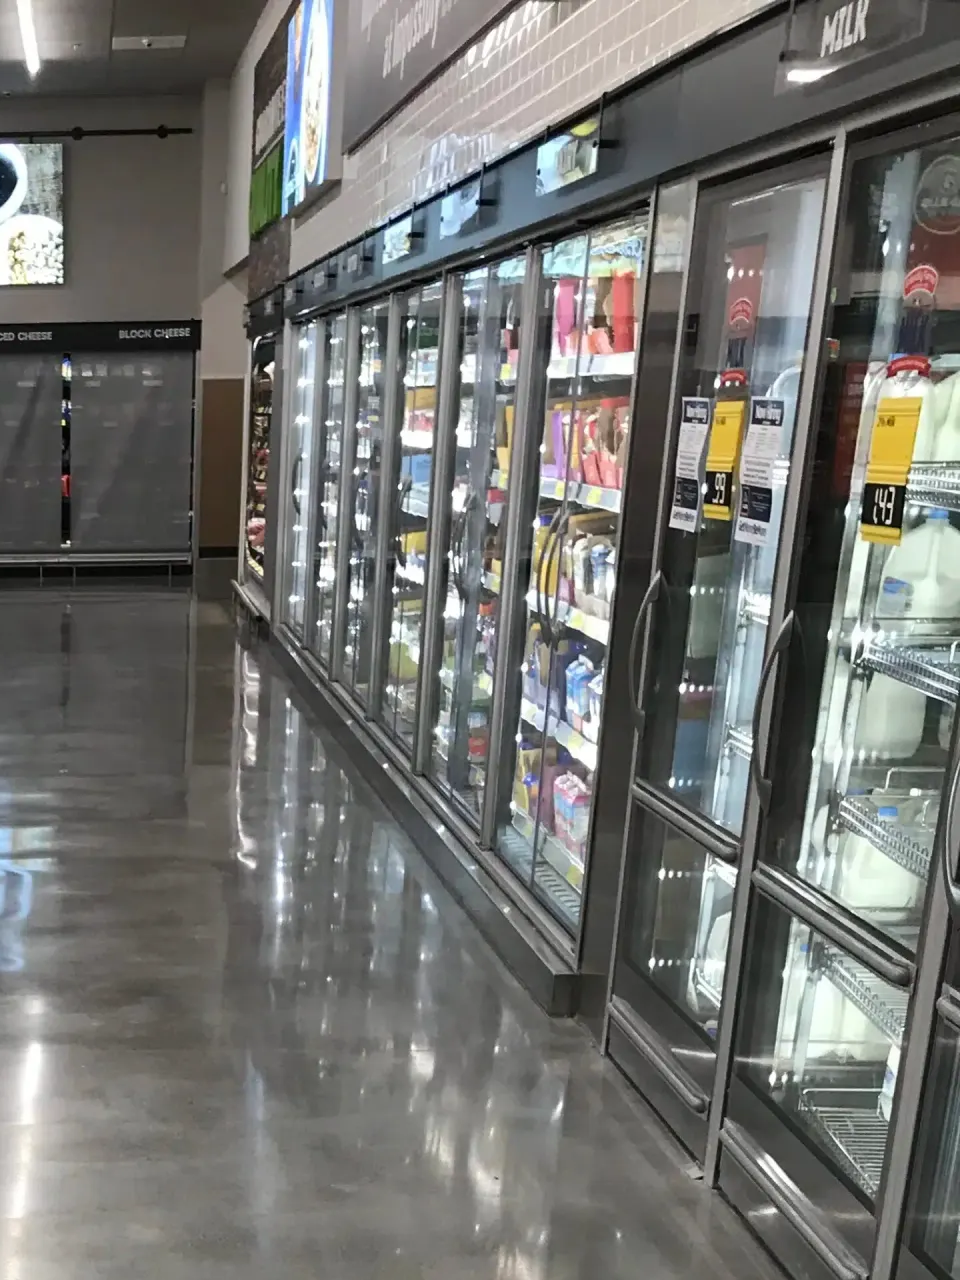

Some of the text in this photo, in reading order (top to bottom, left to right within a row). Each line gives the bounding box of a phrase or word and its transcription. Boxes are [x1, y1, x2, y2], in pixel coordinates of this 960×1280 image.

[820, 0, 869, 58] MILK
[17, 331, 53, 341] CHEESE
[119, 327, 191, 340] BLOCK CHEESE
